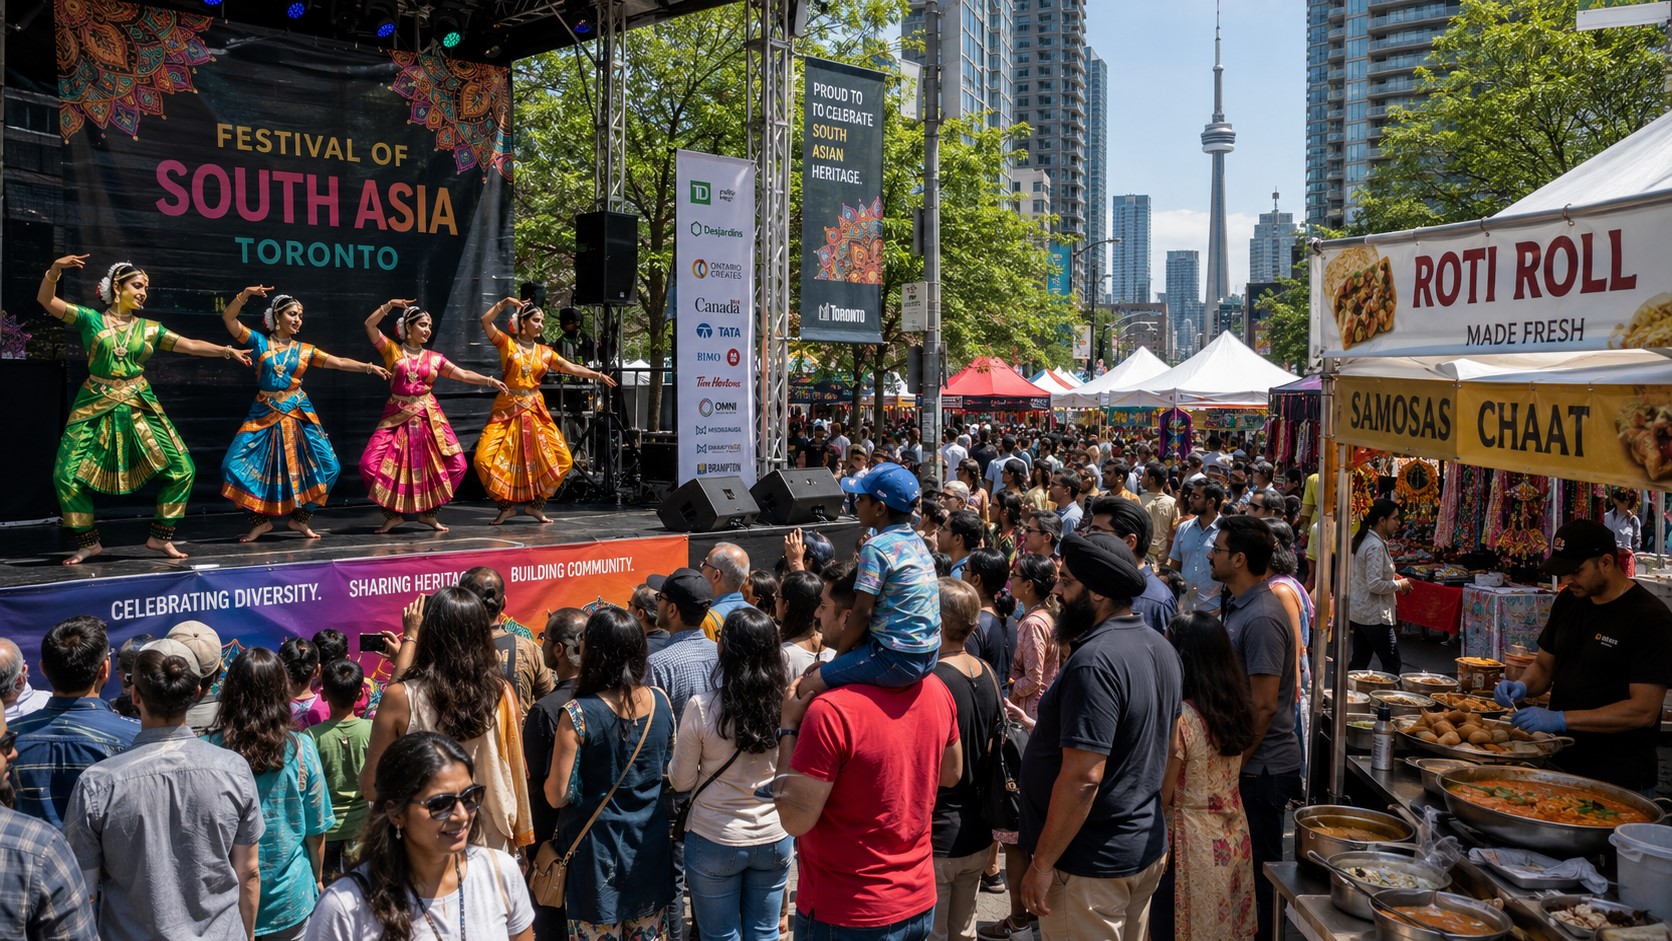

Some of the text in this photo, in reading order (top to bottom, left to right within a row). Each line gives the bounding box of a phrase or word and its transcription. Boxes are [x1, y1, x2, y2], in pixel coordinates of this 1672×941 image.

[813, 81, 863, 105] PROUD TO
[812, 102, 824, 117] TO
[812, 123, 847, 142] SOUTH
[217, 123, 408, 167] FESTIVAL OF
[812, 144, 844, 162] ASIAN
[811, 164, 863, 185] HERITAGE.
[155, 159, 459, 236] SOUTH ASIA
[704, 225, 743, 238] Desjardins
[234, 236, 399, 271] TORONTO
[710, 262, 742, 271] ONTARIO
[710, 270, 742, 280] CREATES
[1413, 229, 1637, 308] ROTI ROLL
[694, 297, 740, 314] Canada
[718, 326, 741, 337] TATA
[1466, 318, 1585, 347] MADE FRESH
[696, 376, 741, 388] Tim Hortons
[715, 402, 737, 411] OMNI
[1350, 391, 1591, 457] SAMOSAS CHAAT
[111, 556, 635, 621] CELEBRATING DIVERSITY. SHARING HERITA BUILDING COMMUNITY.
